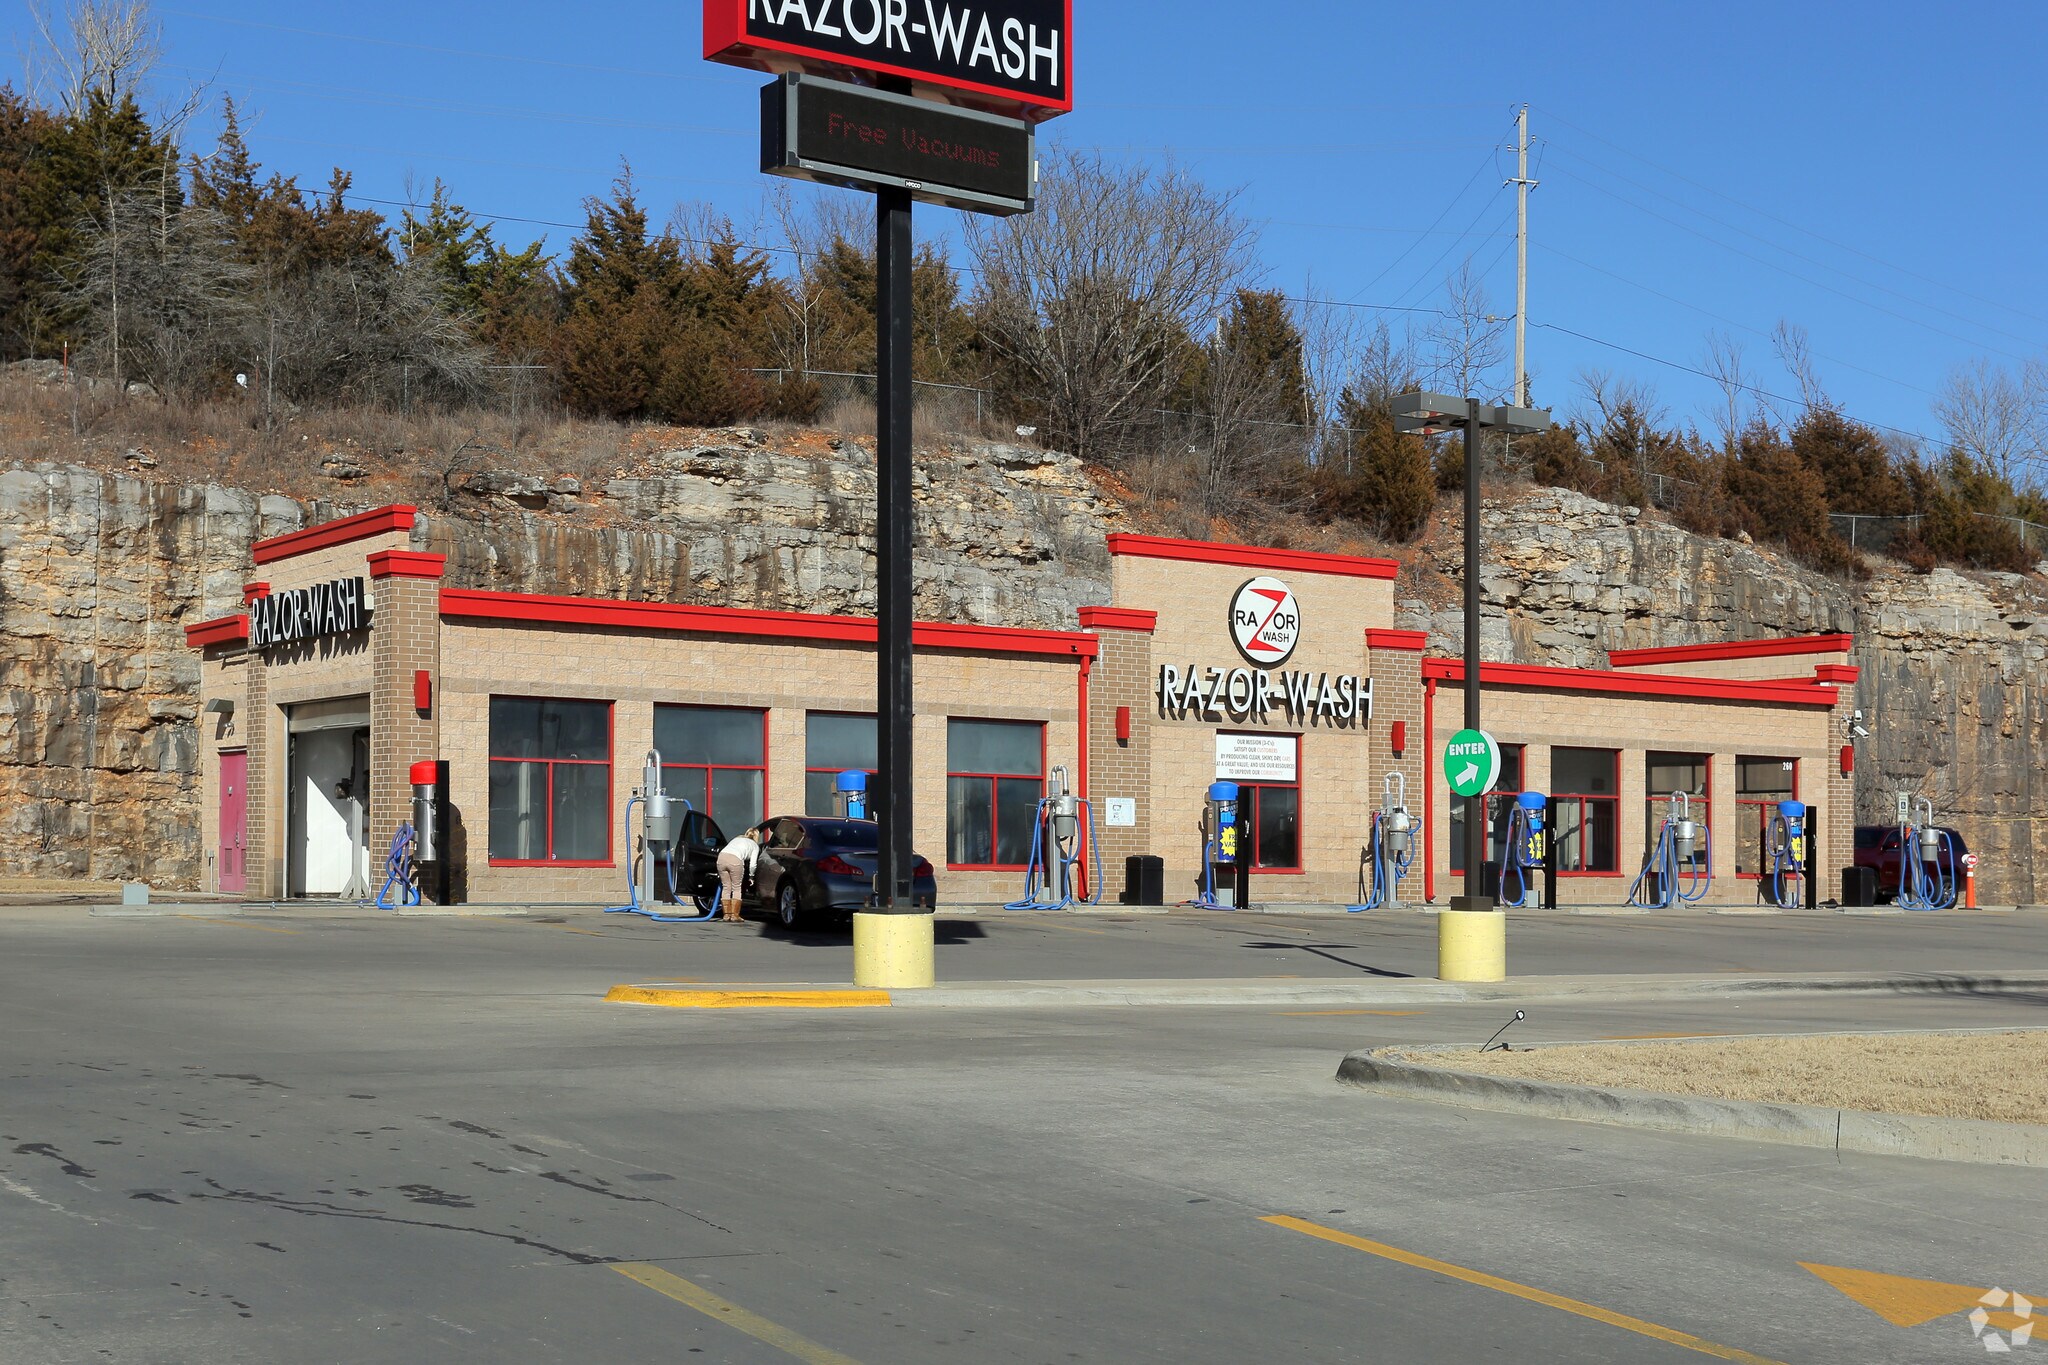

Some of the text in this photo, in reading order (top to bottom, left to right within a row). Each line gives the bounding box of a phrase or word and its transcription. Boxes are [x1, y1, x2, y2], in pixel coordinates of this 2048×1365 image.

[828, 113, 1000, 167] Free Vacuums
[253, 576, 363, 645] RAZOR-WASH
[1262, 631, 1289, 643] WASH
[1449, 742, 1485, 756] ENTER
